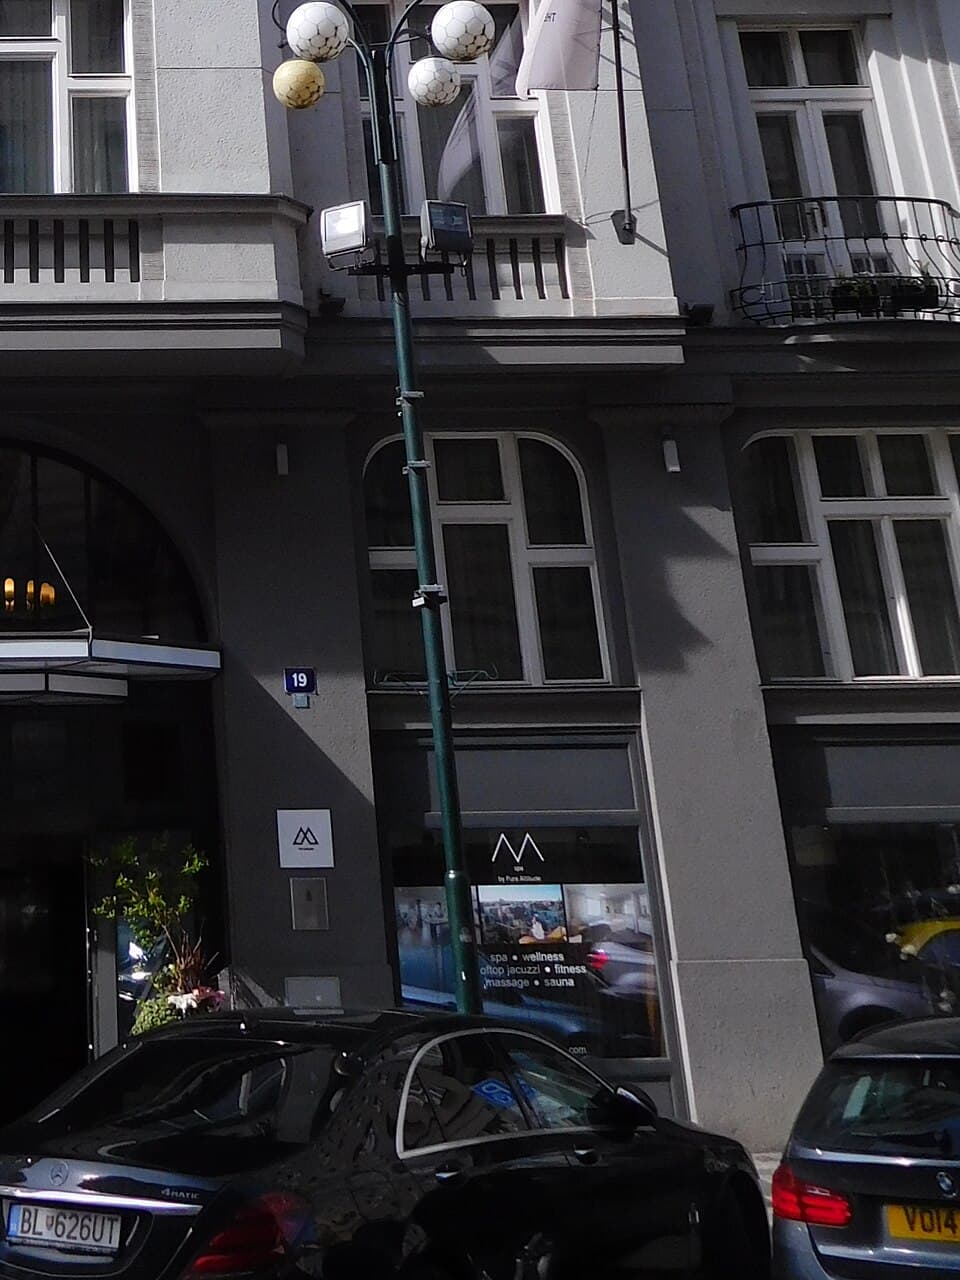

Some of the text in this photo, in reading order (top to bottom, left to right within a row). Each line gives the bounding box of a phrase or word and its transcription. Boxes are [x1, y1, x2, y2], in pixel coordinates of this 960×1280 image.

[291, 672, 308, 688] 19
[490, 951, 565, 963] spa wellness
[507, 965, 540, 976] jacuzzi
[554, 964, 587, 974] fitness
[485, 978, 575, 989] massage sauna
[20, 1206, 120, 1245] BL 626UT
